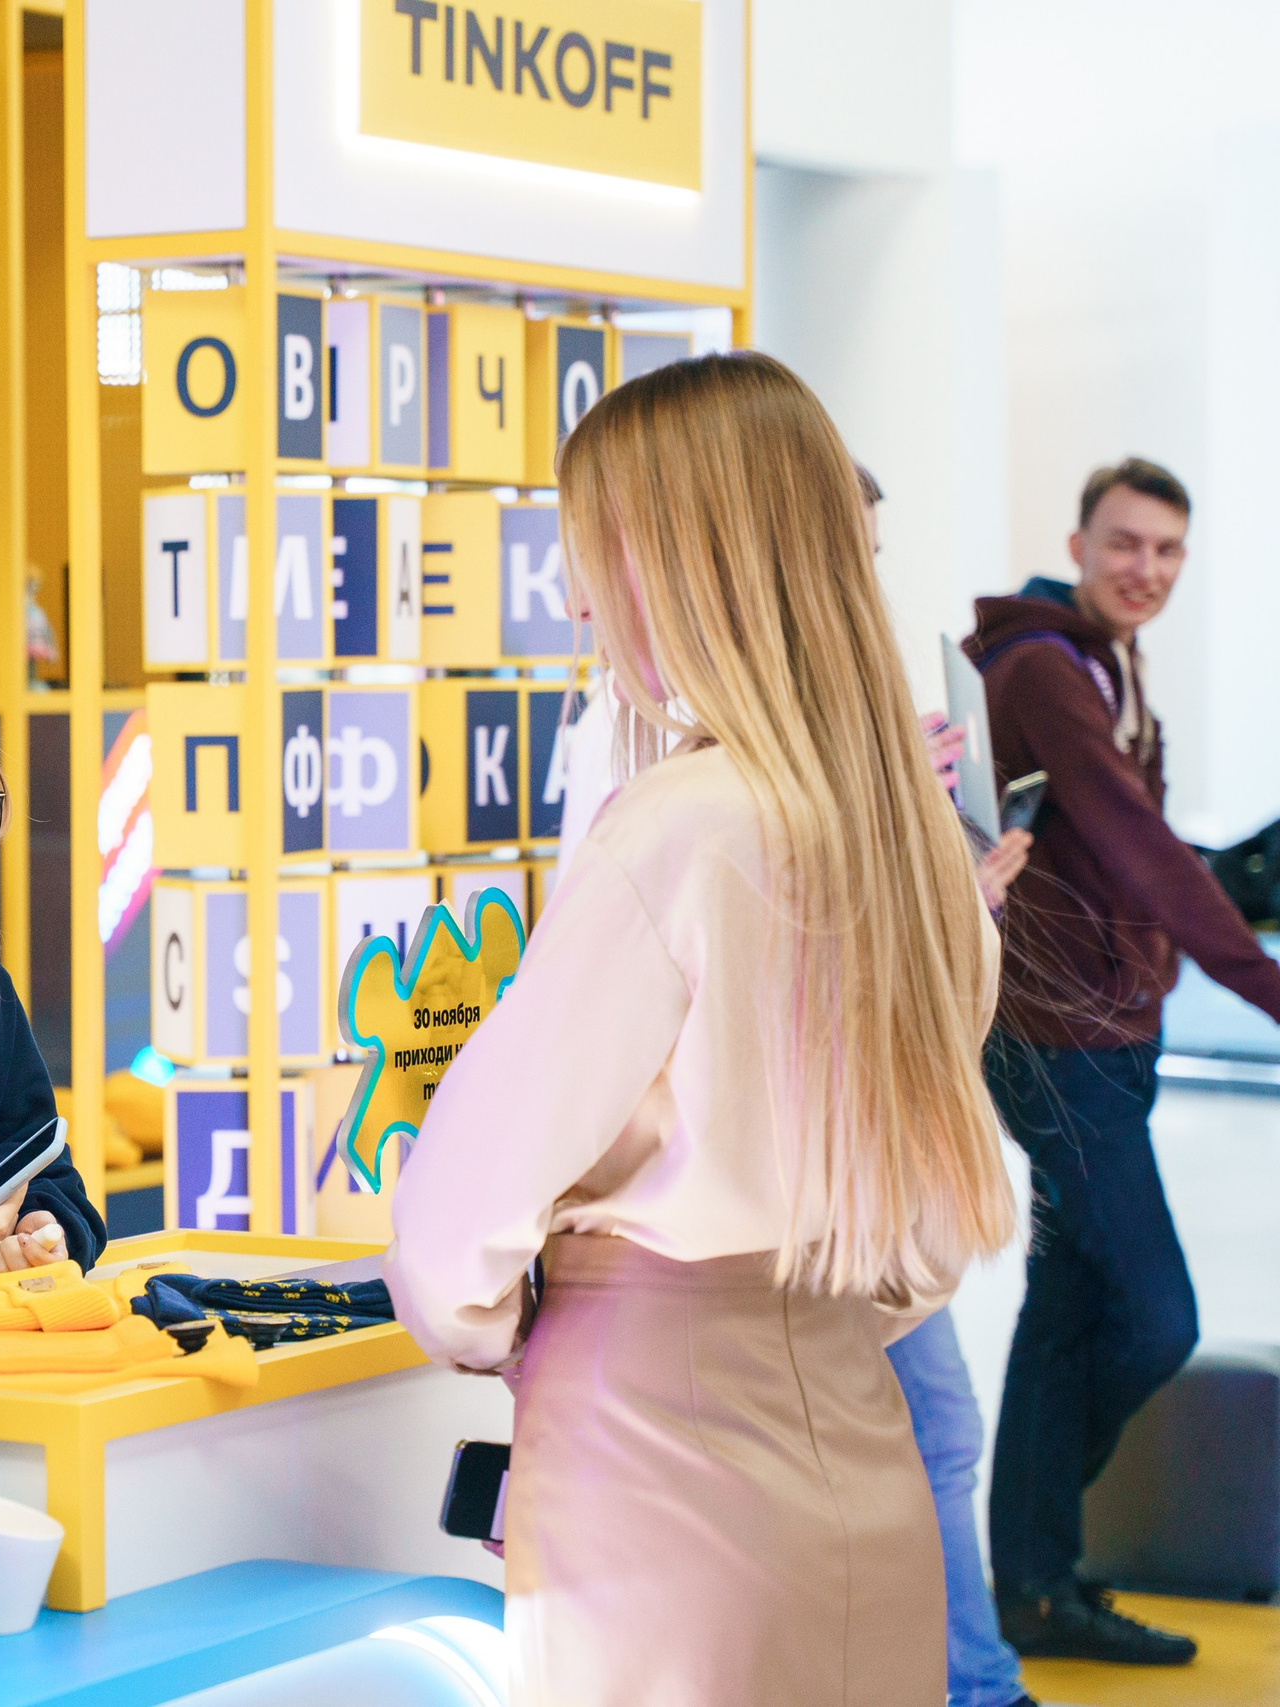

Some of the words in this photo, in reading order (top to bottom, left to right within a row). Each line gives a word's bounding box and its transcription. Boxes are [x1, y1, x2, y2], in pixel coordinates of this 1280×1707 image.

[394, 0, 673, 121] TINKOFF
[414, 1008, 431, 1030] 30
[433, 1002, 480, 1029] ноября
[394, 1044, 453, 1072] приходи
